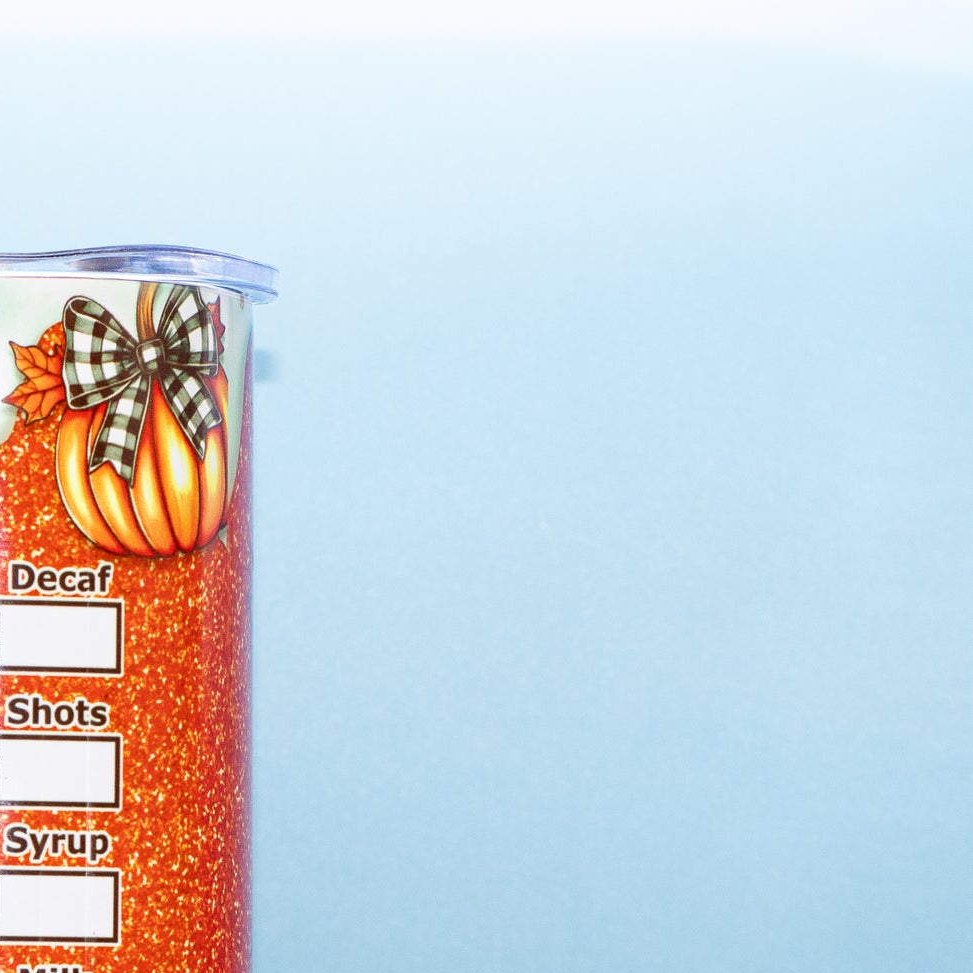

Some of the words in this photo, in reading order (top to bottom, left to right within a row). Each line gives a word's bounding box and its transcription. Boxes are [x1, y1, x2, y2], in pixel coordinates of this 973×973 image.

[11, 563, 111, 592] Decaf
[7, 698, 107, 726] Shots
[6, 826, 109, 861] Syrup
